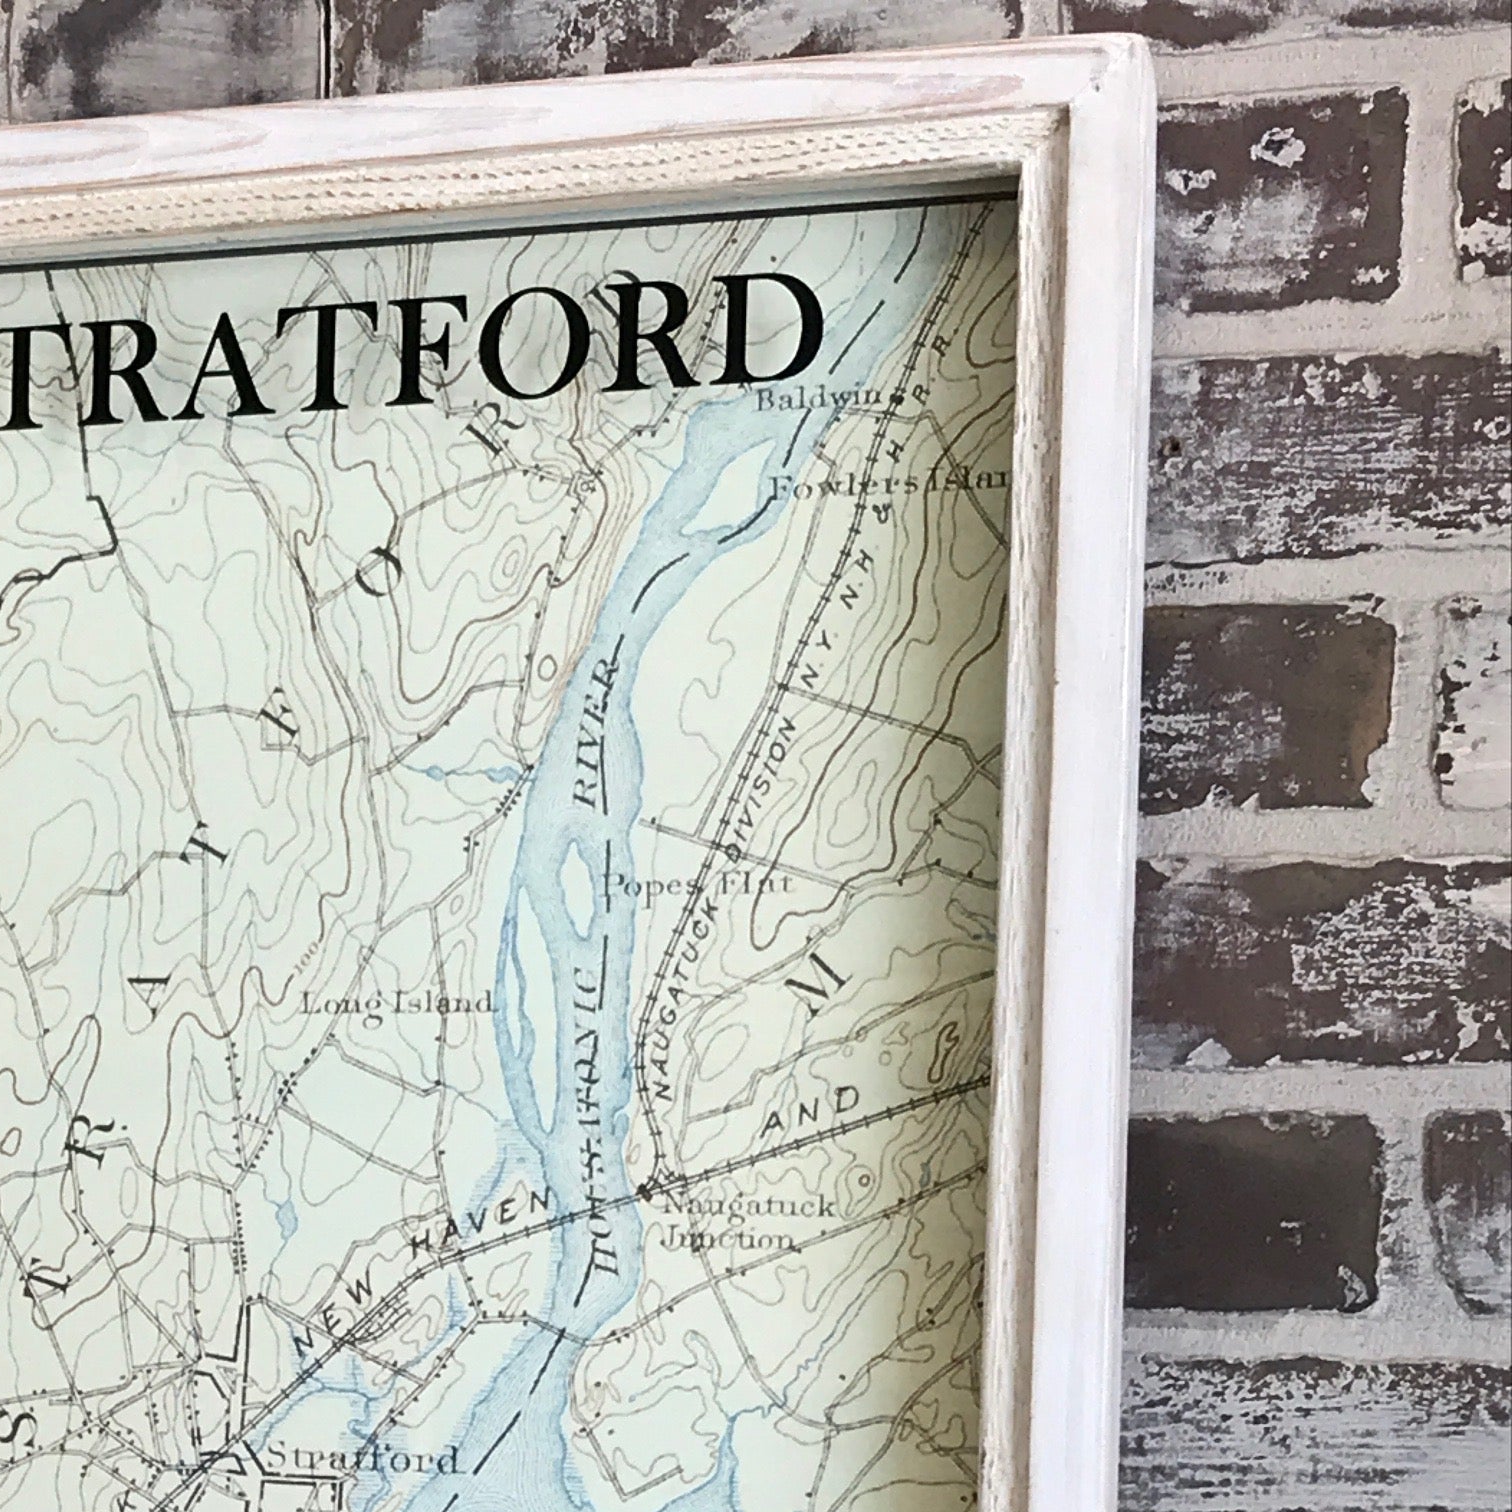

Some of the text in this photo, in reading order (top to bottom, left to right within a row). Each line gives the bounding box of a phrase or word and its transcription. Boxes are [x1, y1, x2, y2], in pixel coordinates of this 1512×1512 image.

[572, 658, 619, 813] RIVER
[601, 872, 701, 910] Popes
[654, 717, 797, 1101] NAUGATUCK DIVISION
[299, 989, 499, 1030] Long Island
[294, 1085, 859, 1357] NEW HAVEN AND
[663, 1194, 836, 1226] Naugatuck
[660, 1224, 796, 1250] Junction
[267, 1440, 467, 1475] Stratford
